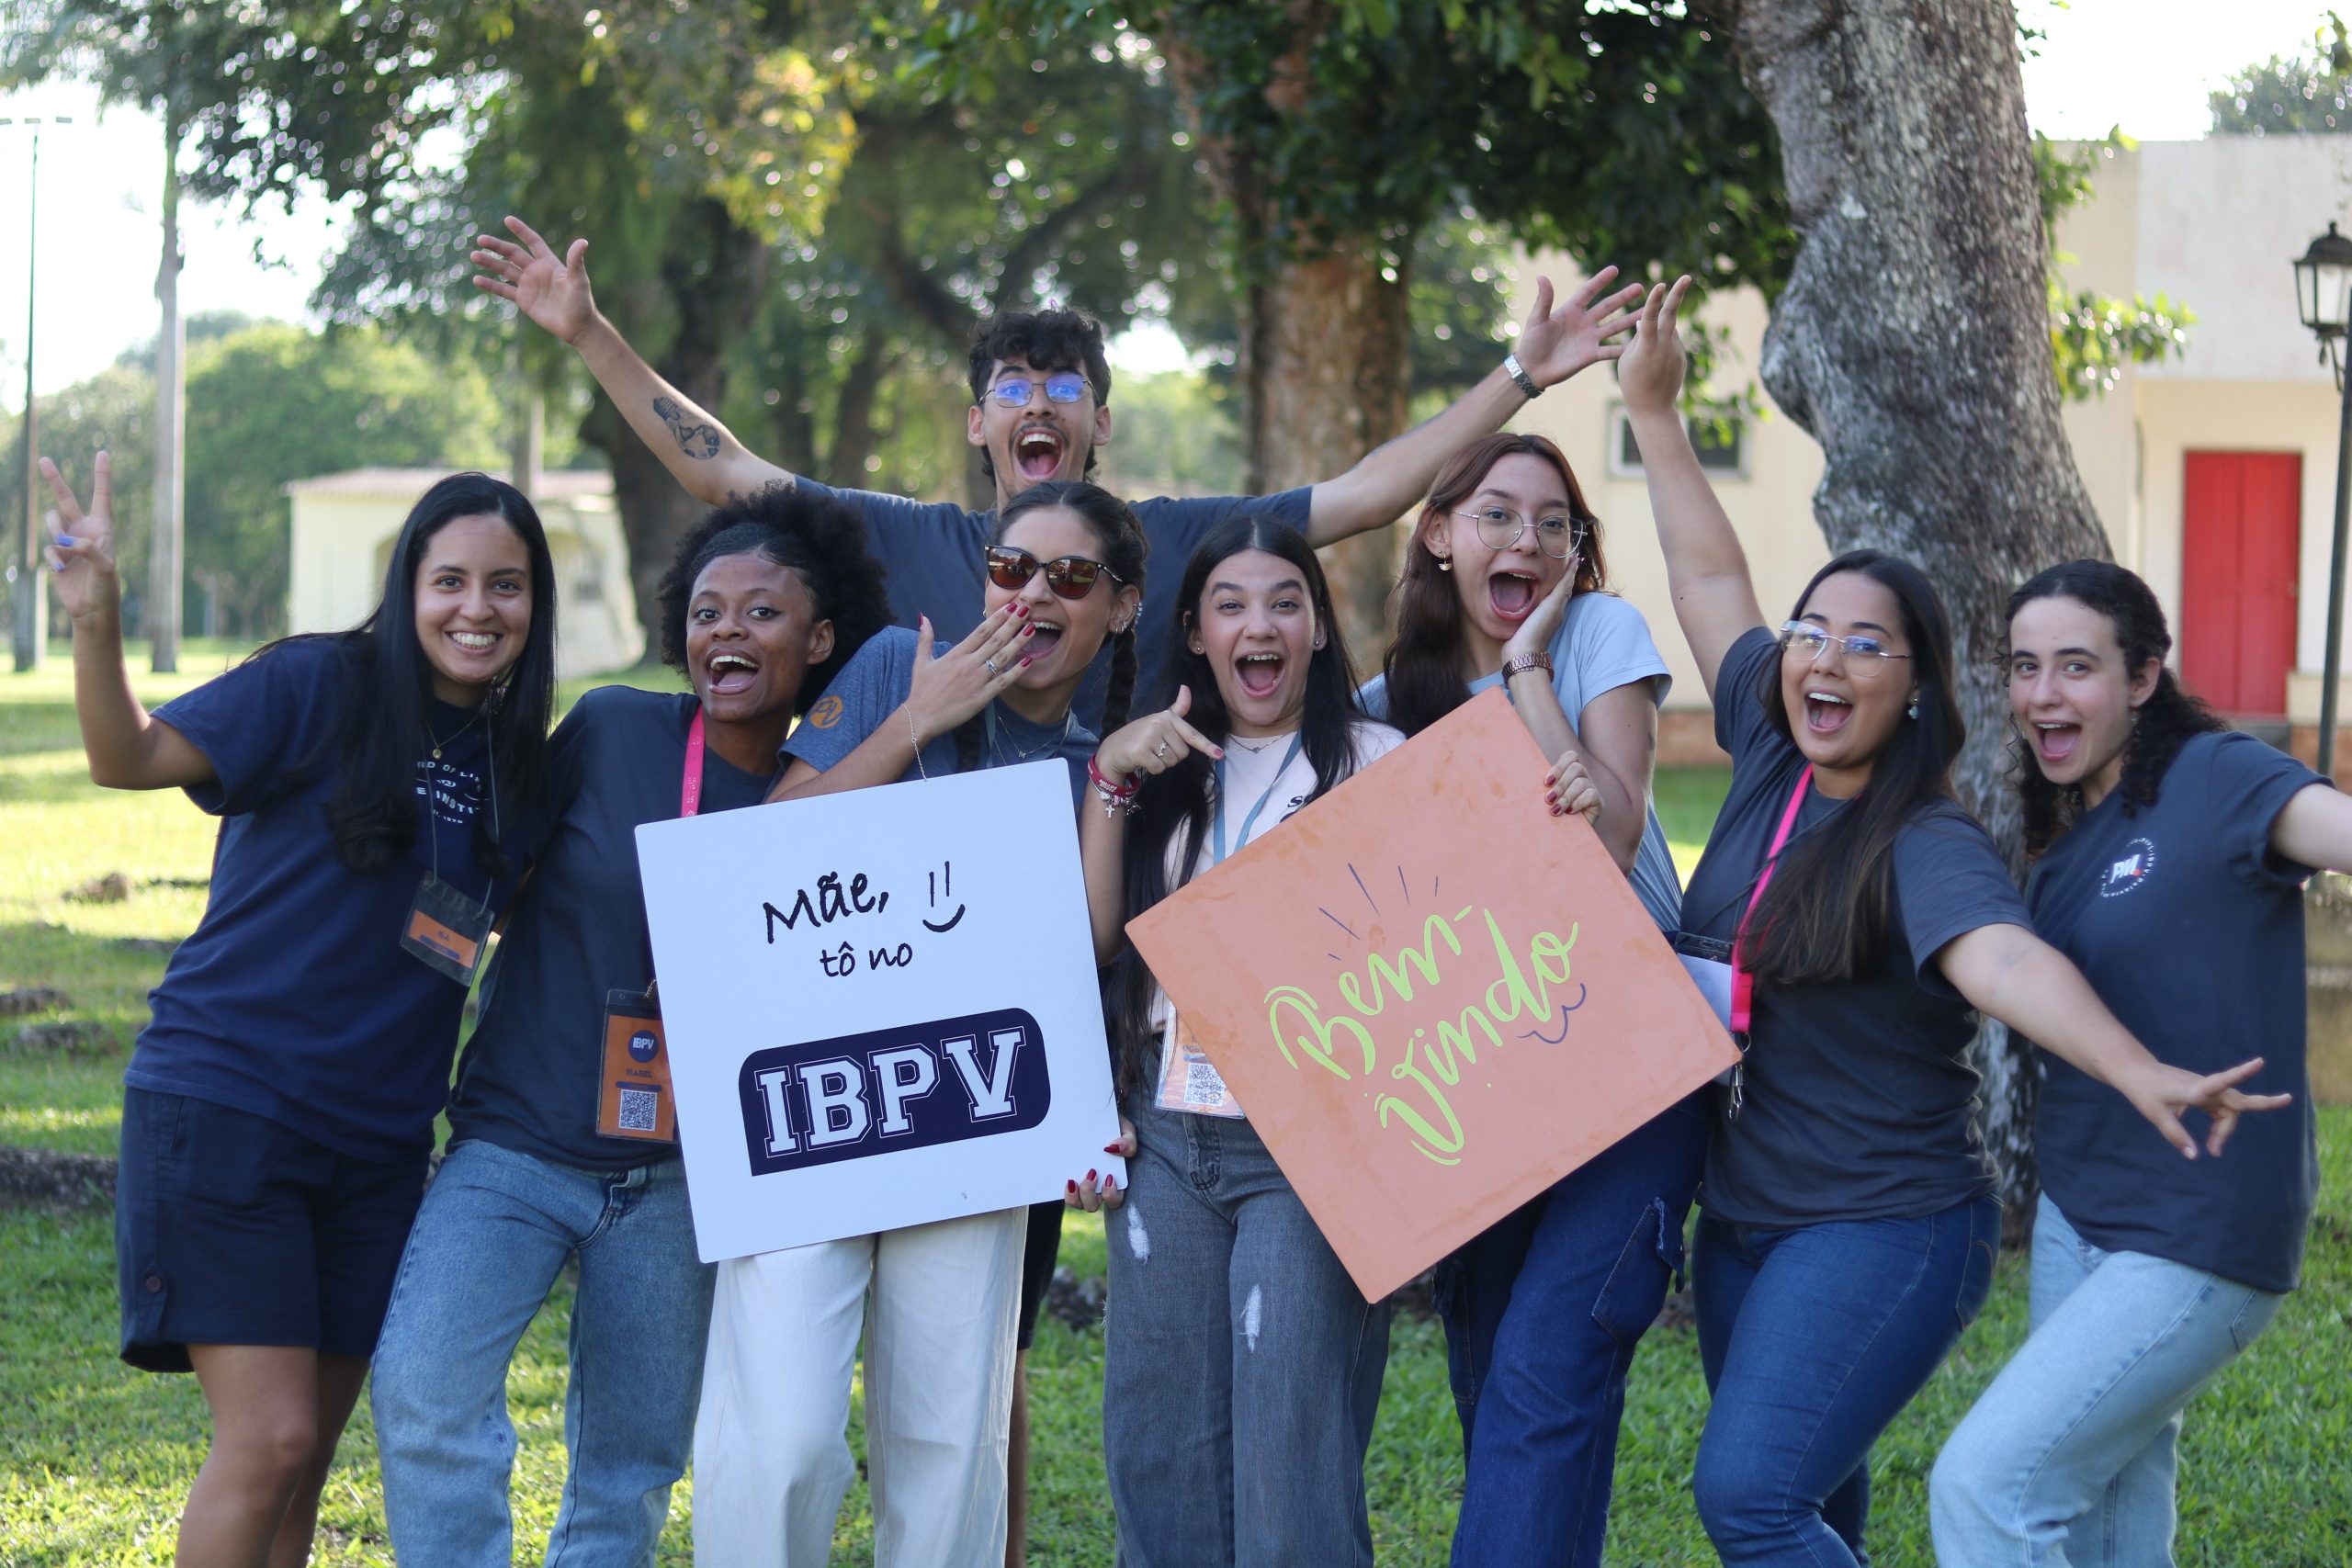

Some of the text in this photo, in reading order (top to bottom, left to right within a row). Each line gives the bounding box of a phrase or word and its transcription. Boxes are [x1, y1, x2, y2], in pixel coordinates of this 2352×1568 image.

[416, 761, 435, 769] RD
[443, 764, 457, 773] OF
[435, 790, 481, 815] INSTI
[763, 872, 888, 944] Mãe,
[820, 942, 913, 977] tô no
[632, 1037, 655, 1050] IBPV
[754, 1026, 1026, 1158] IBPV
